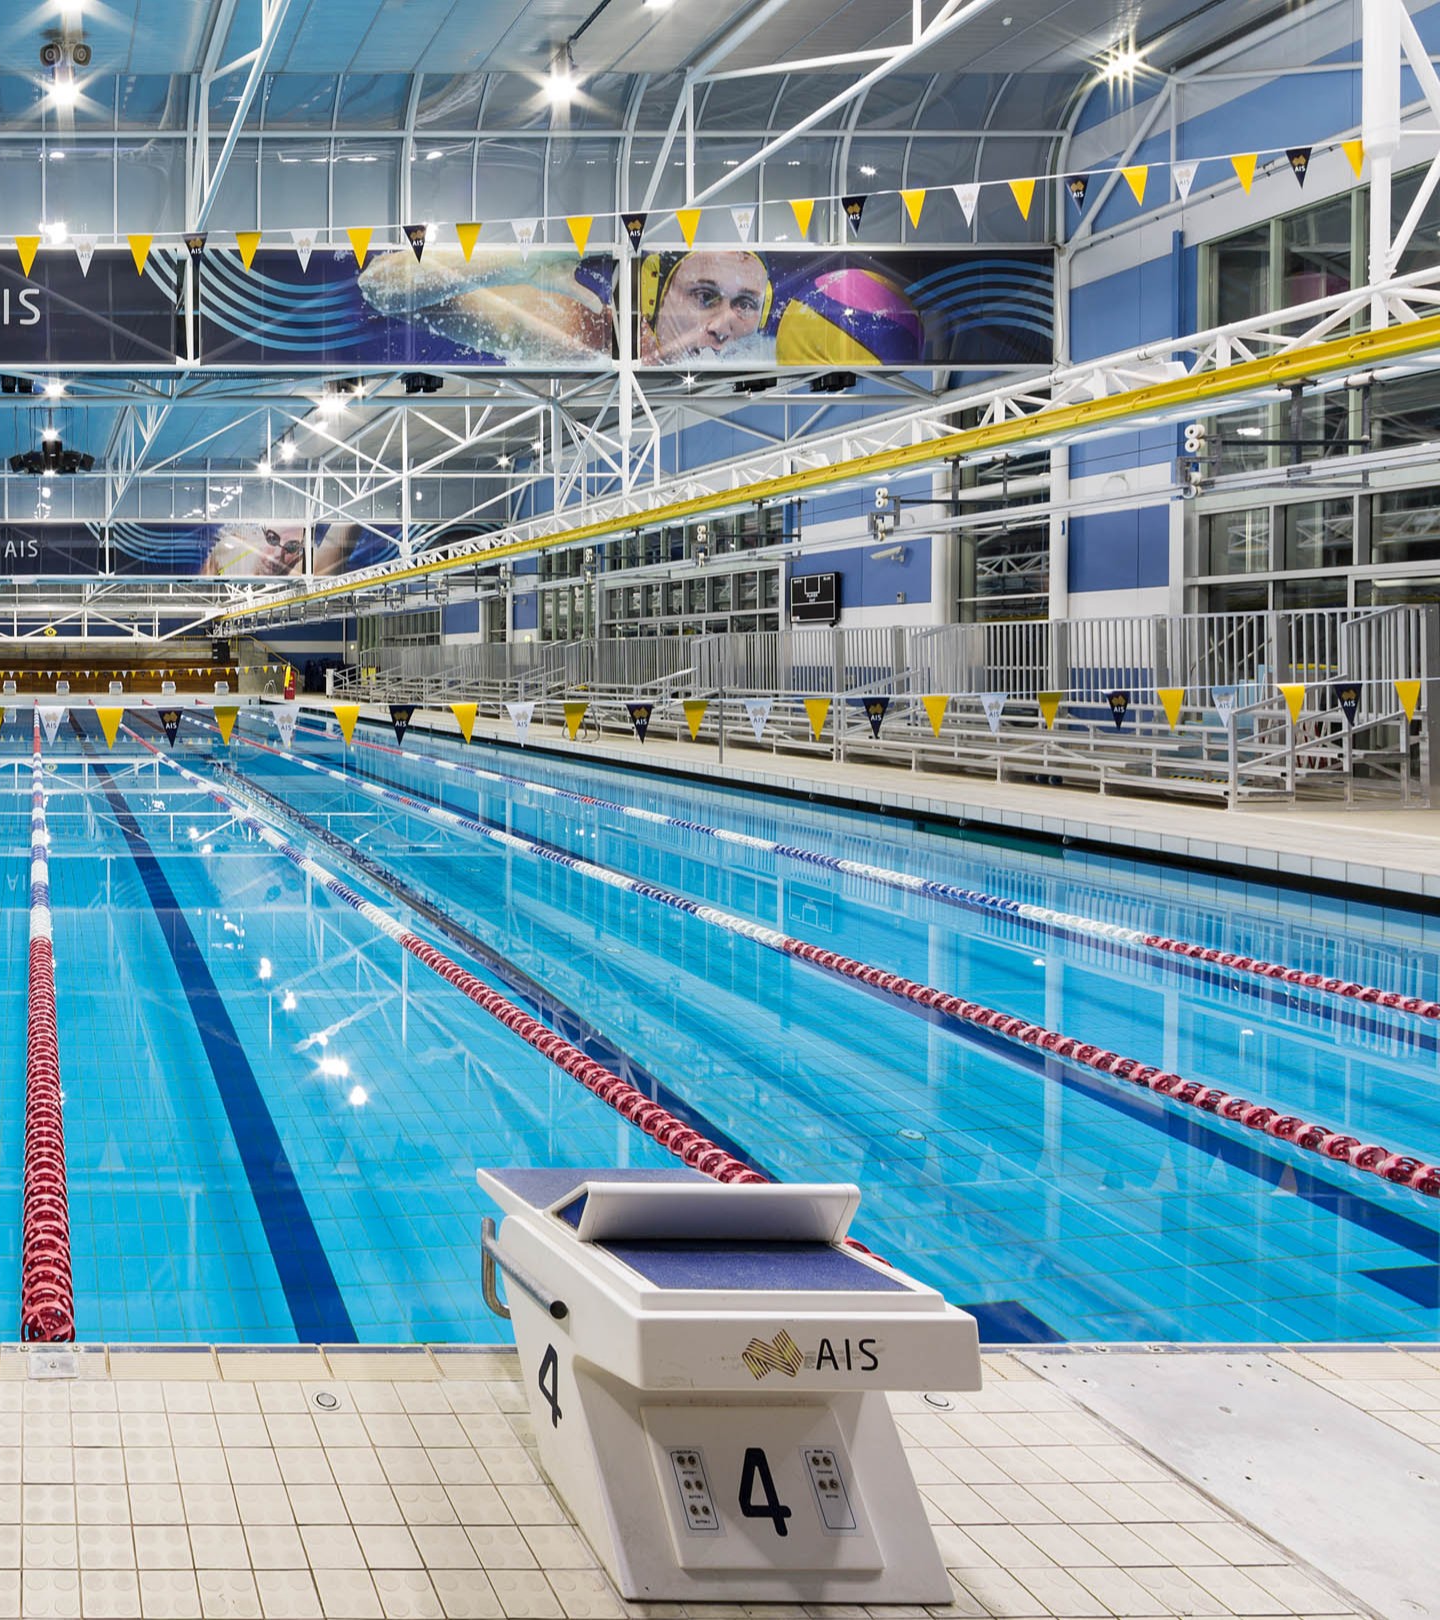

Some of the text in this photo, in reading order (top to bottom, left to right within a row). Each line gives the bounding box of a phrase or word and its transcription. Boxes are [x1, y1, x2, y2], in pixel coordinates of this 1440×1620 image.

[4, 540, 38, 558] AIS
[815, 1338, 879, 1371] AIS
[538, 1343, 562, 1429] 4
[738, 1447, 792, 1537] 4
